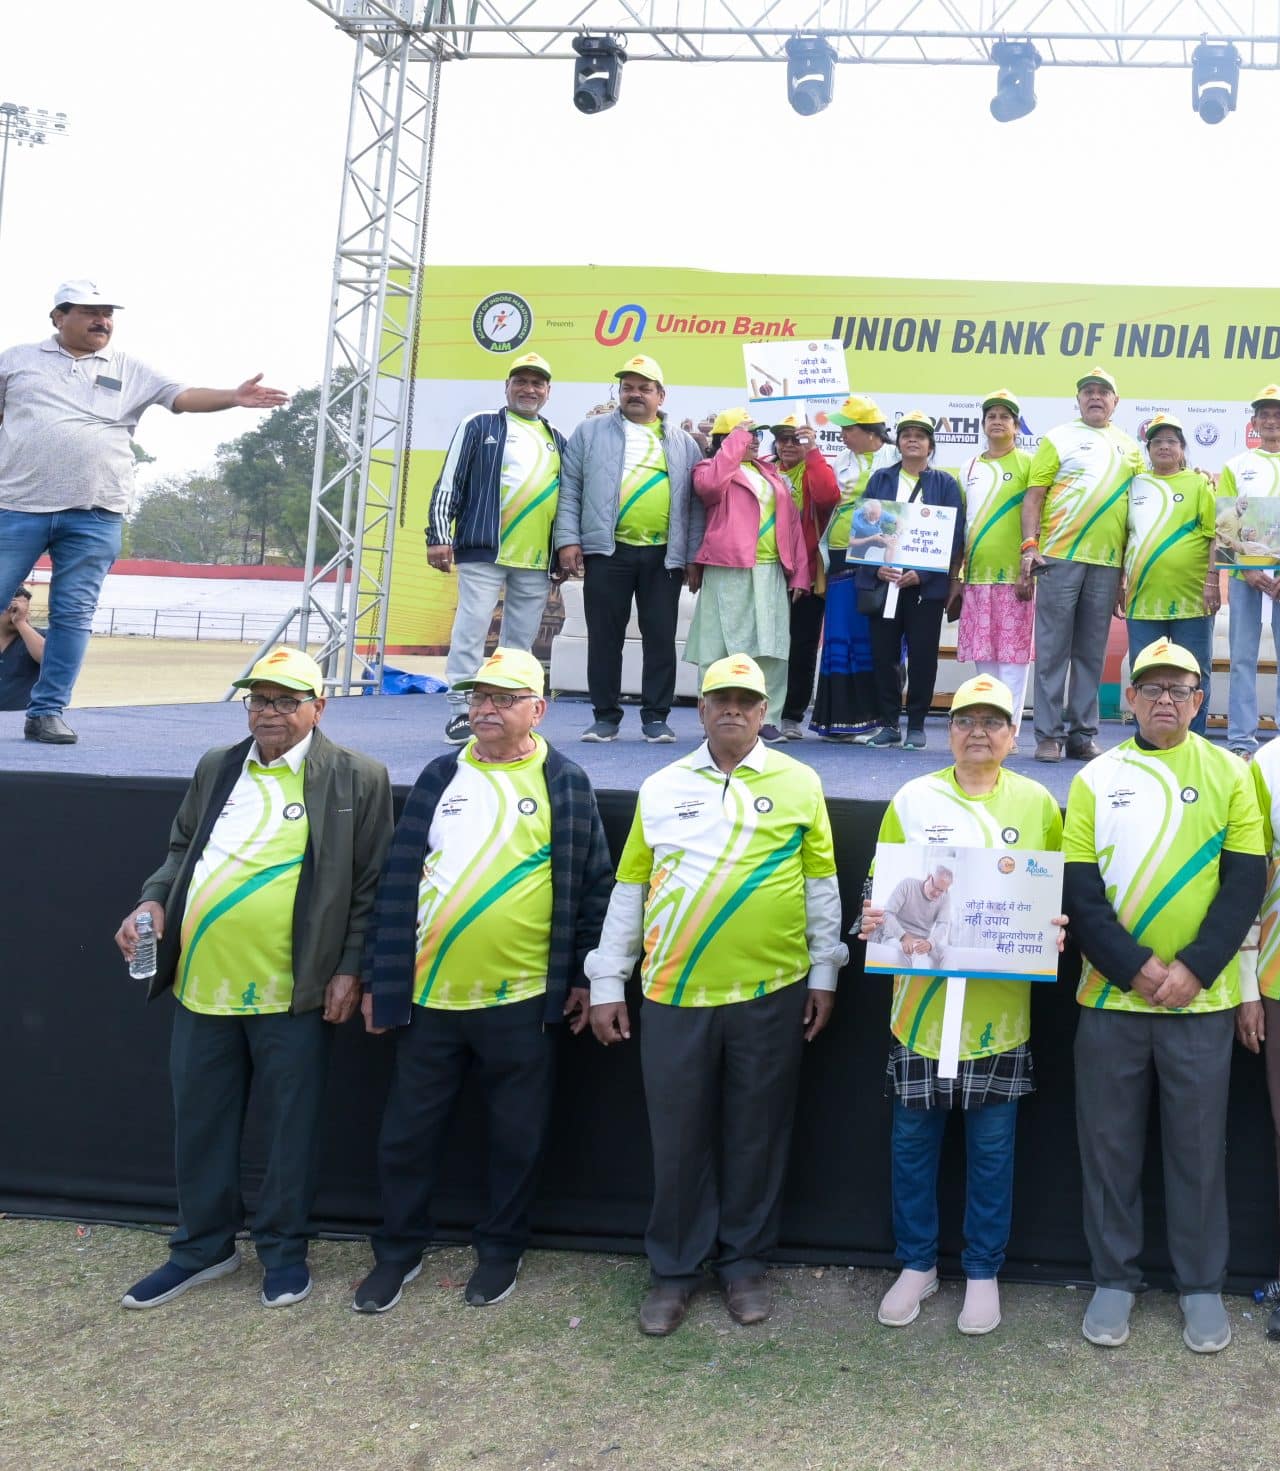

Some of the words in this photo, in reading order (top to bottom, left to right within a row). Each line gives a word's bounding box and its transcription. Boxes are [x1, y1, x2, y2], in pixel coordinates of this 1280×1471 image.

[546, 320, 574, 328] Presents
[656, 314, 727, 335] Union
[732, 316, 797, 337] Bank
[832, 316, 941, 353] UNION
[951, 320, 1051, 355] BANK
[1060, 322, 1104, 357] OF
[1113, 323, 1211, 359] INDIA
[935, 434, 976, 443] UNDATION
[965, 912, 982, 926] नहीं
[985, 916, 1010, 926] उपाय
[1037, 931, 1043, 941] है
[996, 940, 1014, 954] सही
[1018, 944, 1043, 954] उपाय
